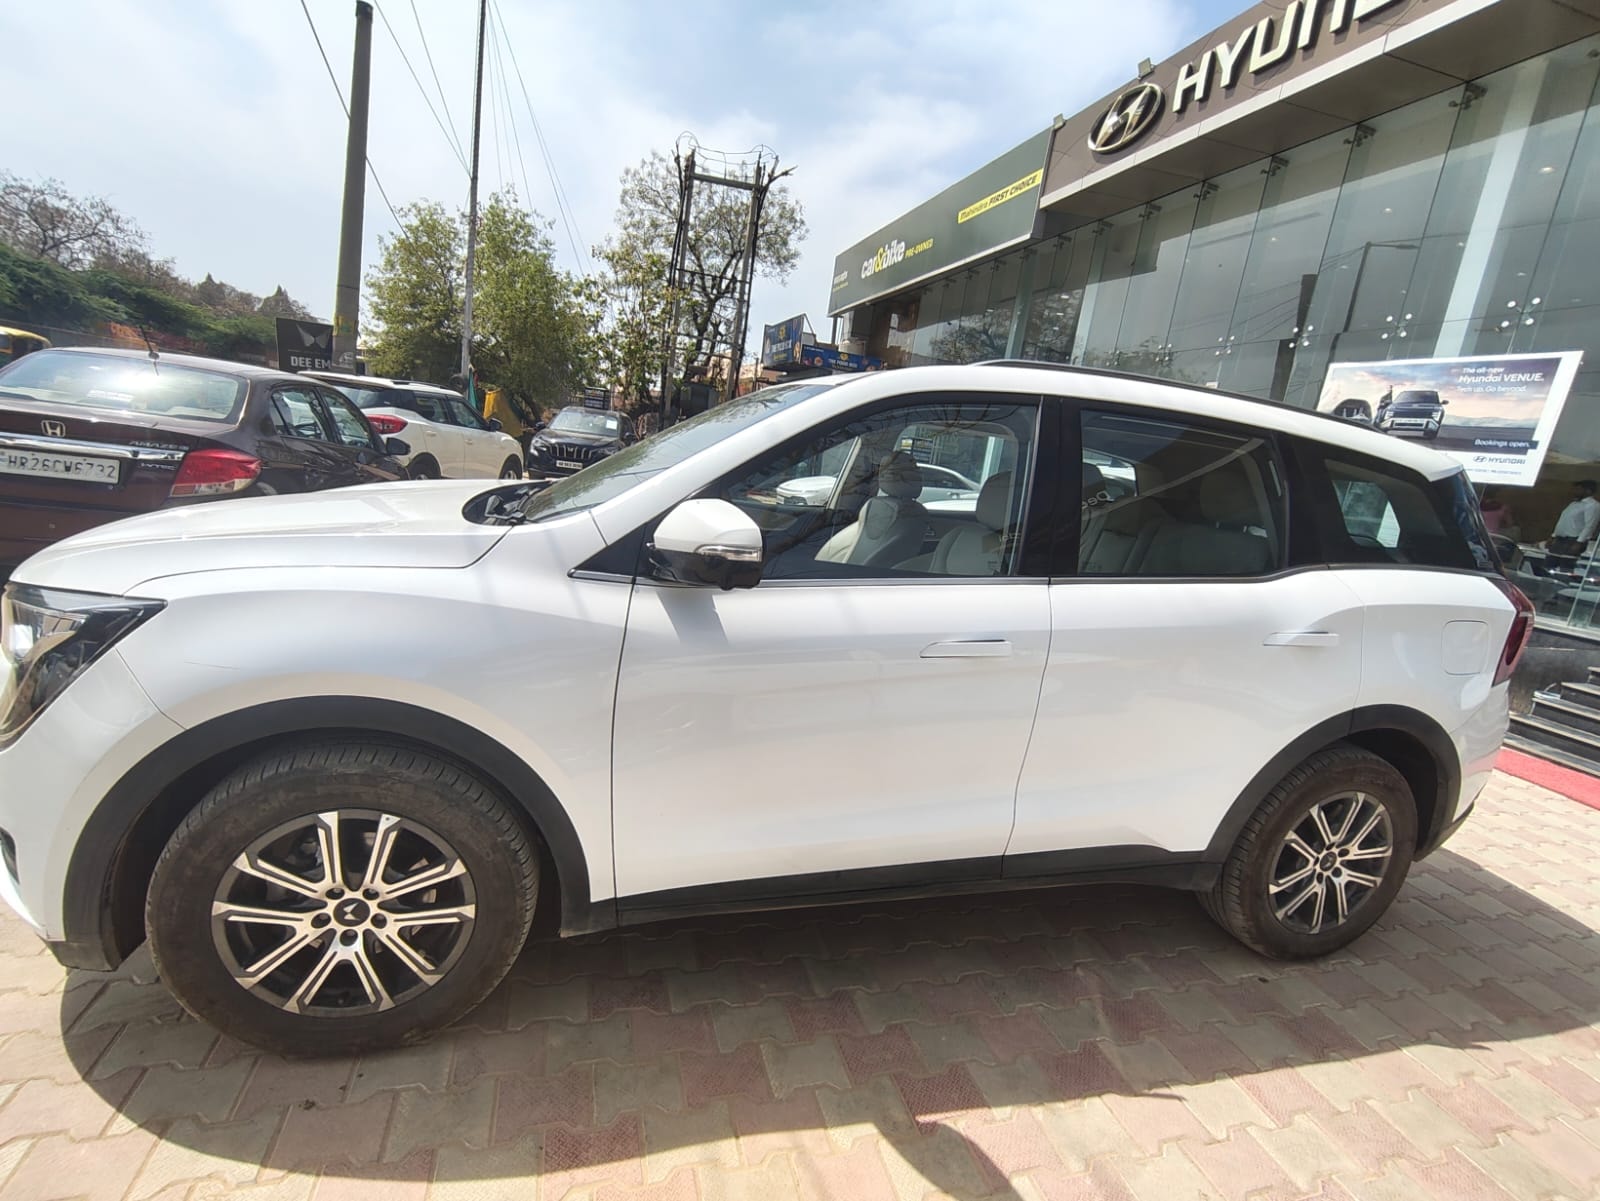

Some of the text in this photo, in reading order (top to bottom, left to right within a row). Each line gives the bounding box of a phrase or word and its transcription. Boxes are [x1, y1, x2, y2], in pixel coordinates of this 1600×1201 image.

[1171, 0, 1391, 113] HYUN
[988, 189, 1009, 207] FIRST
[1009, 175, 1037, 196] CHOICE
[861, 239, 905, 279] car&bike
[290, 355, 313, 368] DEE
[1459, 374, 1502, 385] Hyundai
[1474, 438, 1508, 448] Bookings
[1488, 456, 1526, 465] HYUNDAI
